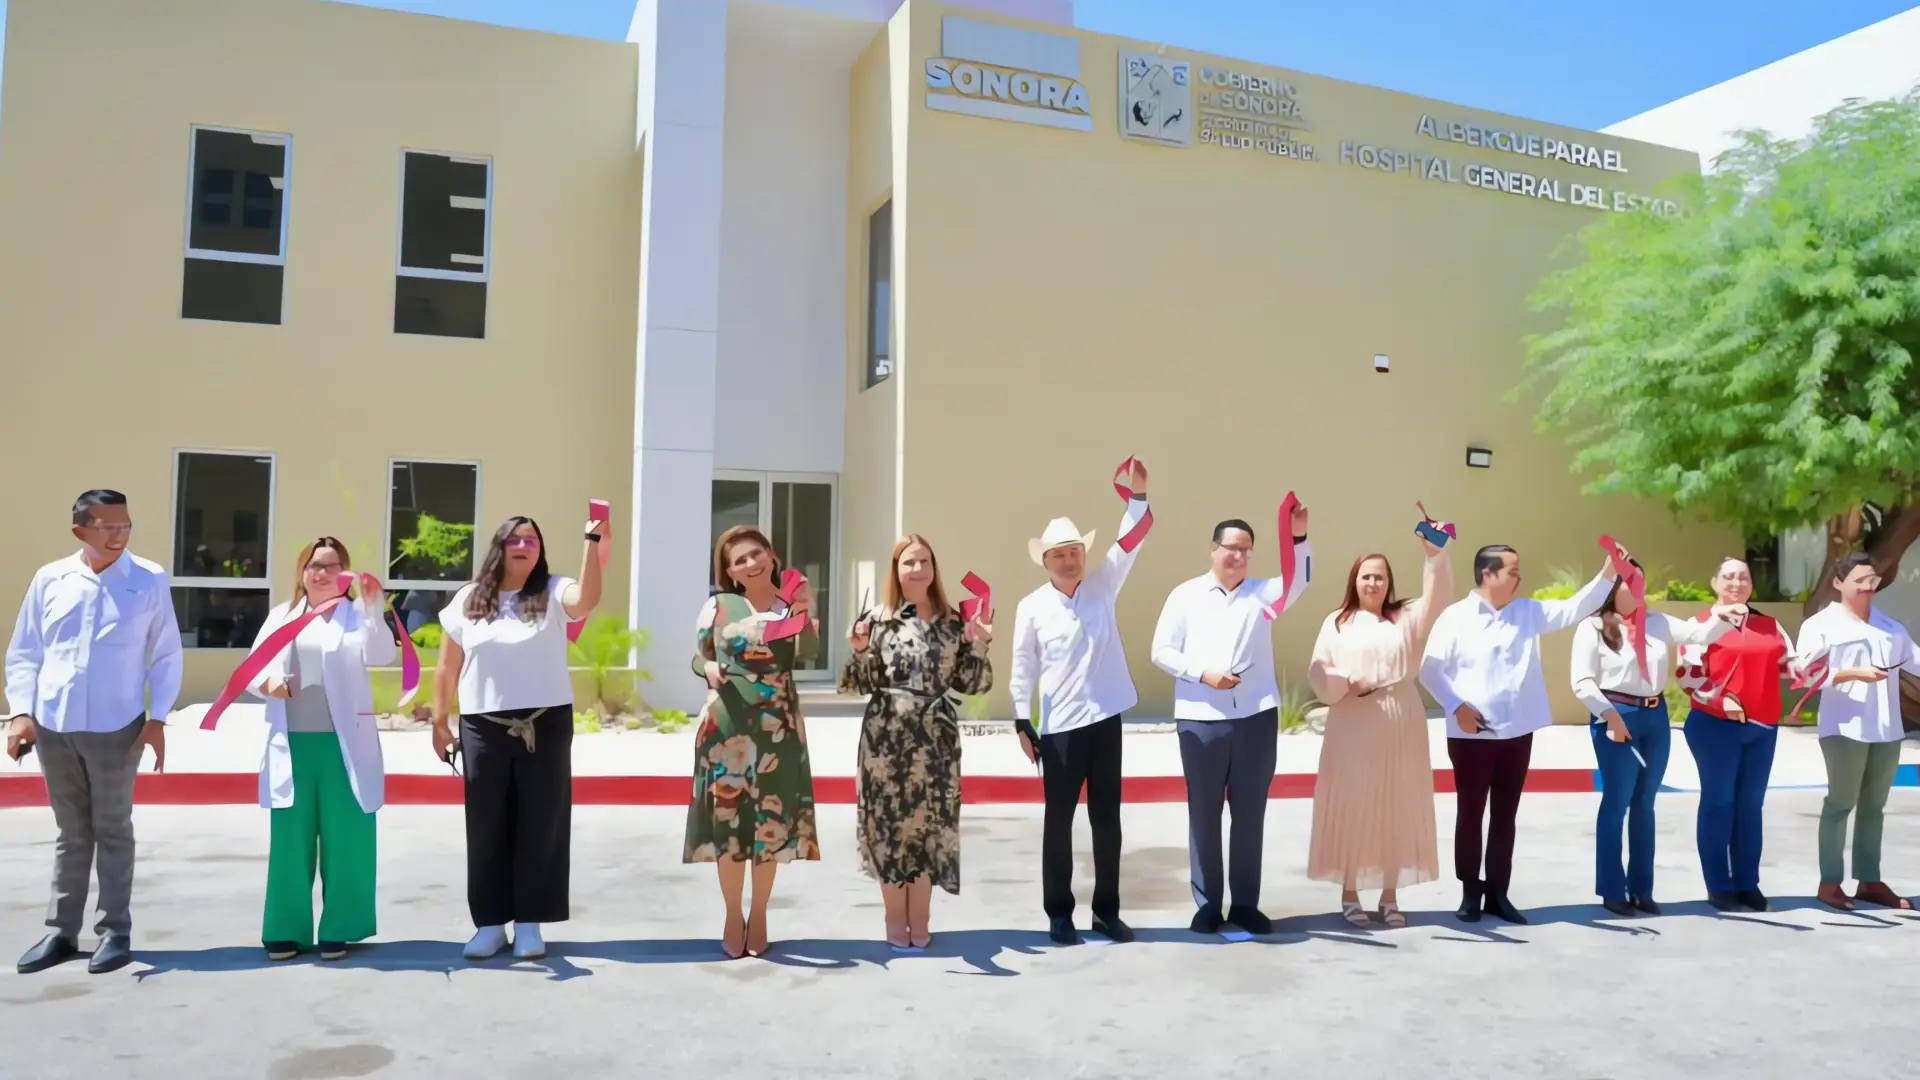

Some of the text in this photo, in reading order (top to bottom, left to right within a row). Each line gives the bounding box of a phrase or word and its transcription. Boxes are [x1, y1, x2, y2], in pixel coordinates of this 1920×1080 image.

[925, 57, 1091, 115] SONORA
[1221, 91, 1304, 121] SONORA
[1416, 114, 1628, 173] ALBERGUE PARA EL
[1338, 140, 1460, 182] HOSPITAL
[1463, 164, 1567, 203] GENERAL
[1570, 183, 1610, 211] DEL
